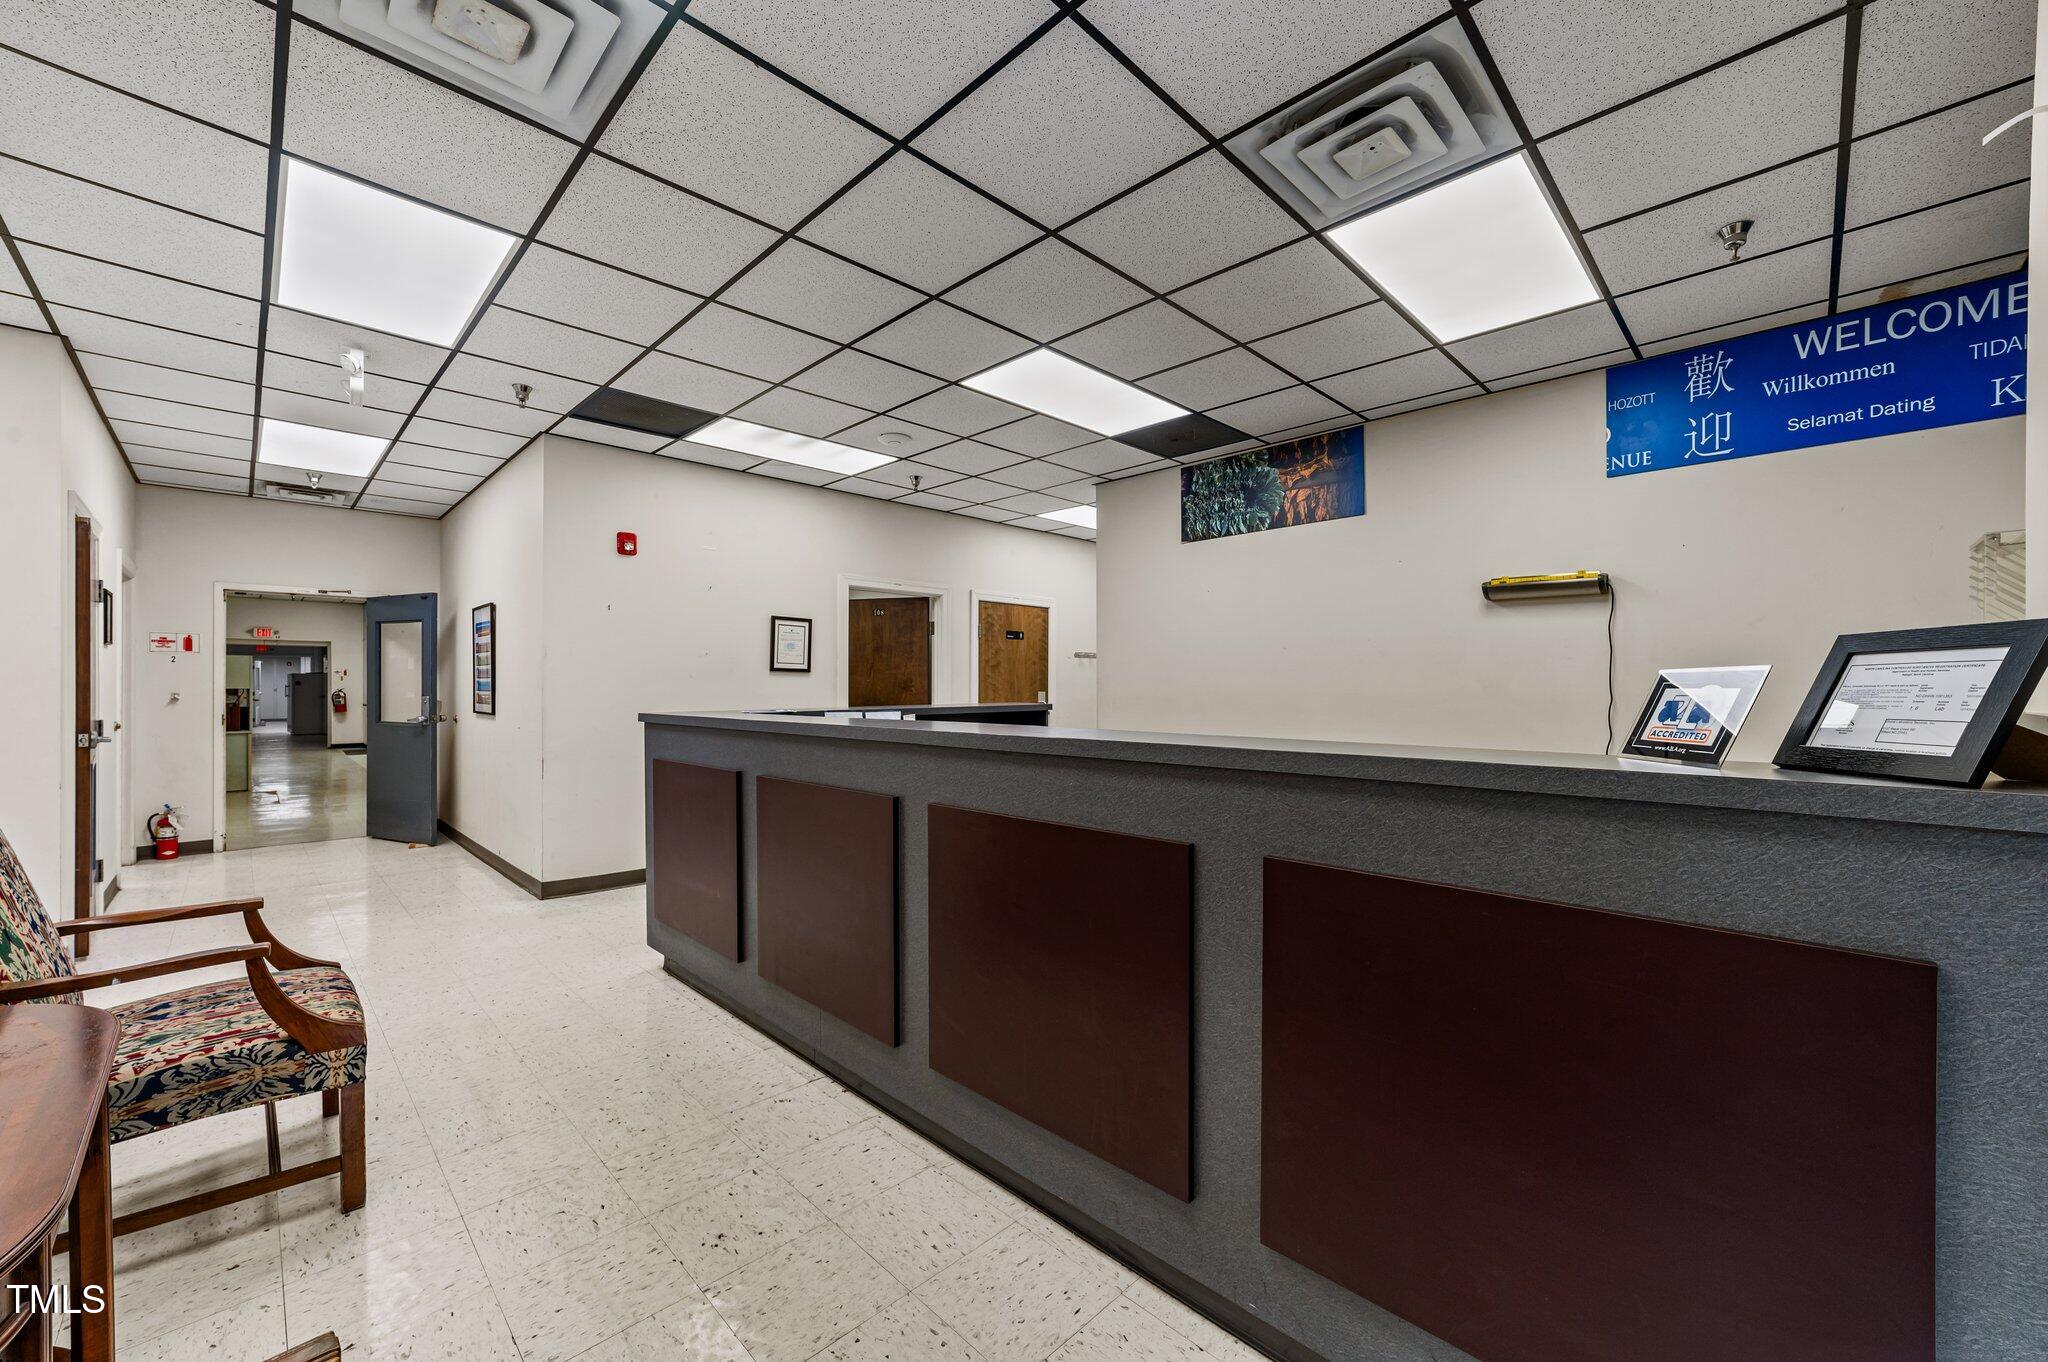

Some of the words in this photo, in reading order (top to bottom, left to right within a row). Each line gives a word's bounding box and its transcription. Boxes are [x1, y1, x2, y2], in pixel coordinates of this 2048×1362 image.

[1793, 281, 2028, 360] WELCOME
[1762, 361, 1896, 397] Willkommen
[1990, 374, 2027, 407] K
[1608, 392, 1656, 412] HOZOTT
[1787, 407, 1864, 431] Selamat
[1870, 396, 1936, 418] Dating
[256, 628, 272, 637] EXIT
[171, 655, 176, 663] 2
[1650, 730, 1707, 741] ACCREDITED
